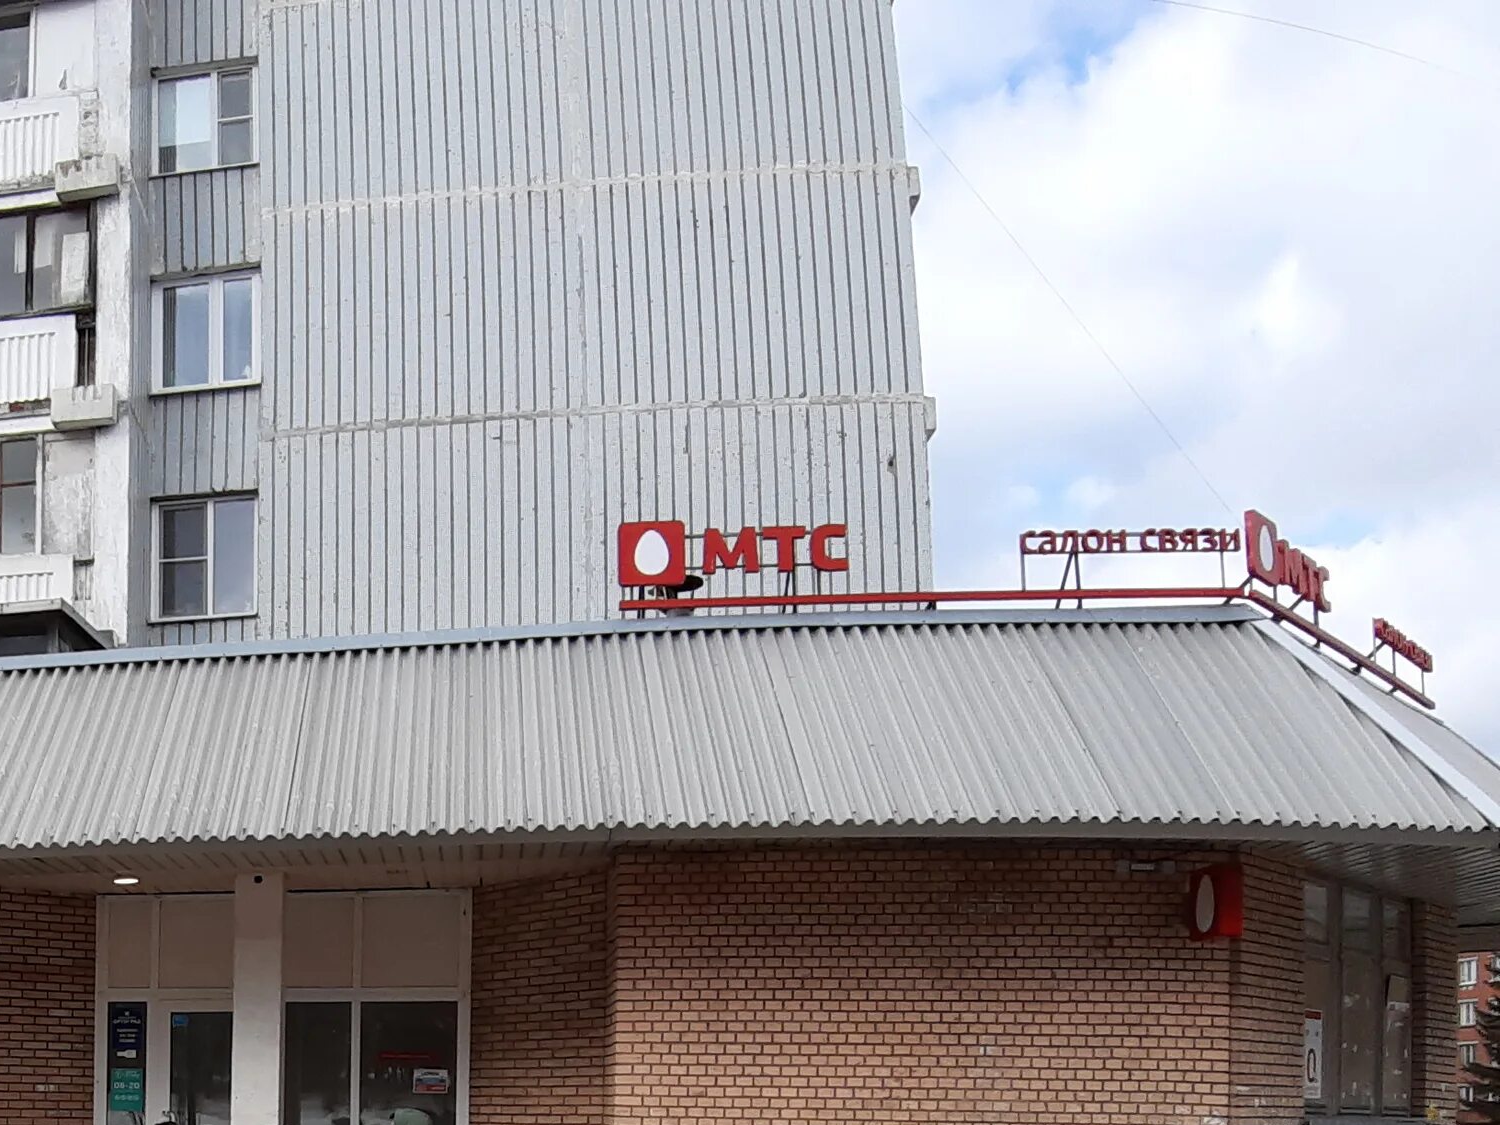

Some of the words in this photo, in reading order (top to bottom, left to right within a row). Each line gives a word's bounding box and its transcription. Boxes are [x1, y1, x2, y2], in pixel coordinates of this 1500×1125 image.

[702, 523, 850, 574] МТС
[1020, 529, 1127, 554] салон
[1140, 528, 1241, 552] связи
